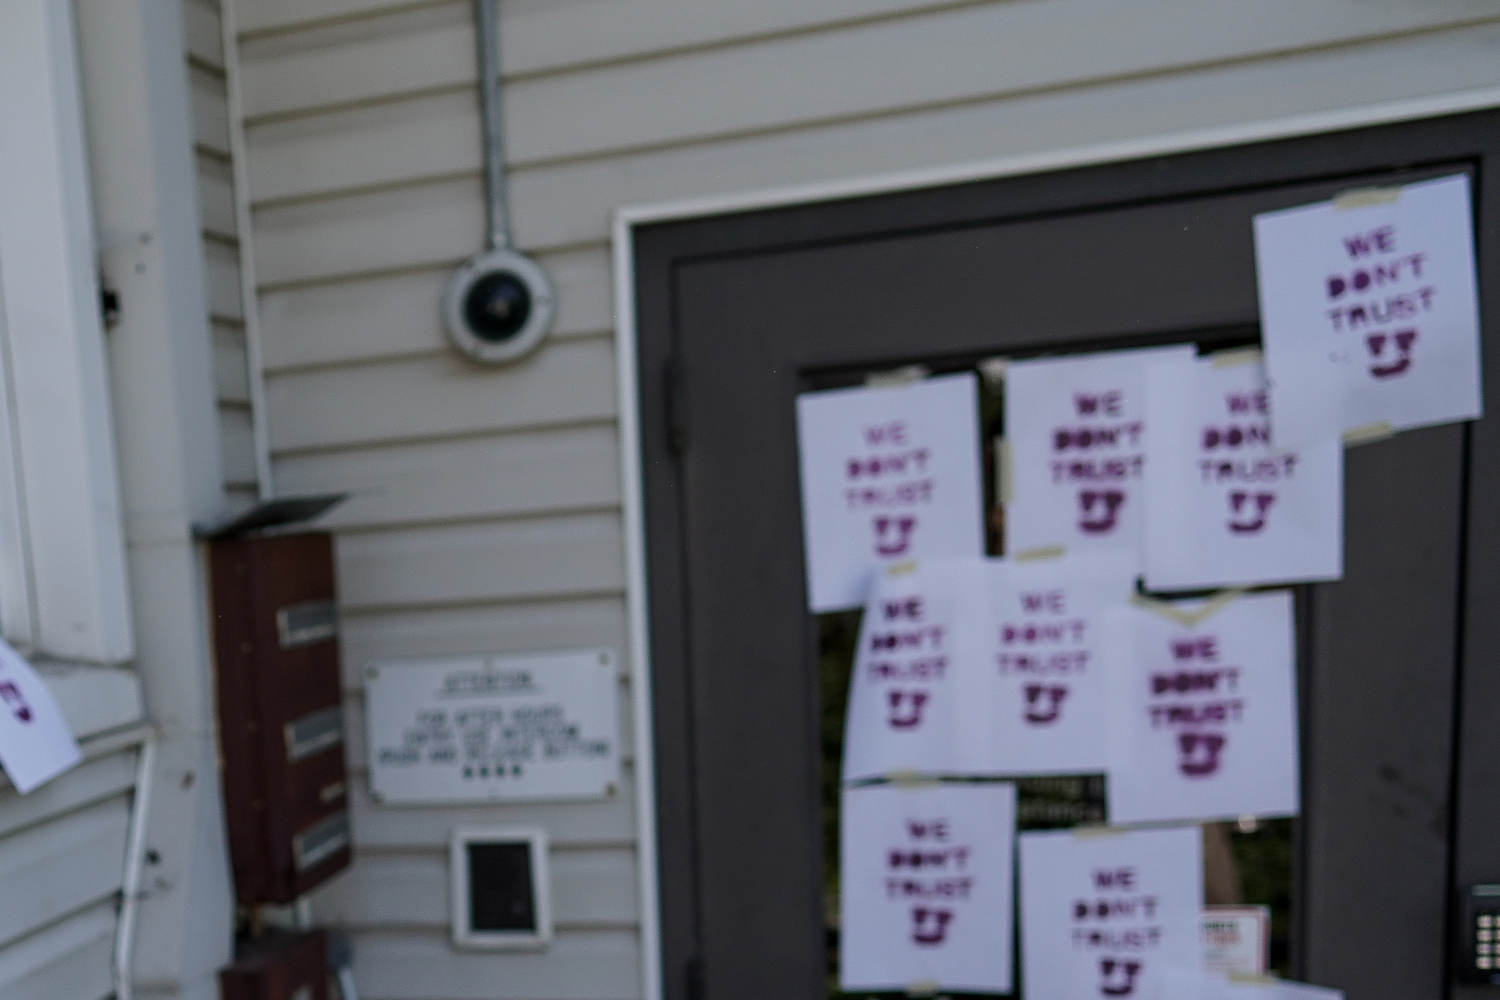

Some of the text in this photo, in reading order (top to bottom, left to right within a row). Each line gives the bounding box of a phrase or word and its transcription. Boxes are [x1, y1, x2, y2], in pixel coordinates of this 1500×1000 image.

[1343, 225, 1399, 258] WE
[1324, 254, 1428, 302] DON'T
[1325, 287, 1436, 333] TRUST
